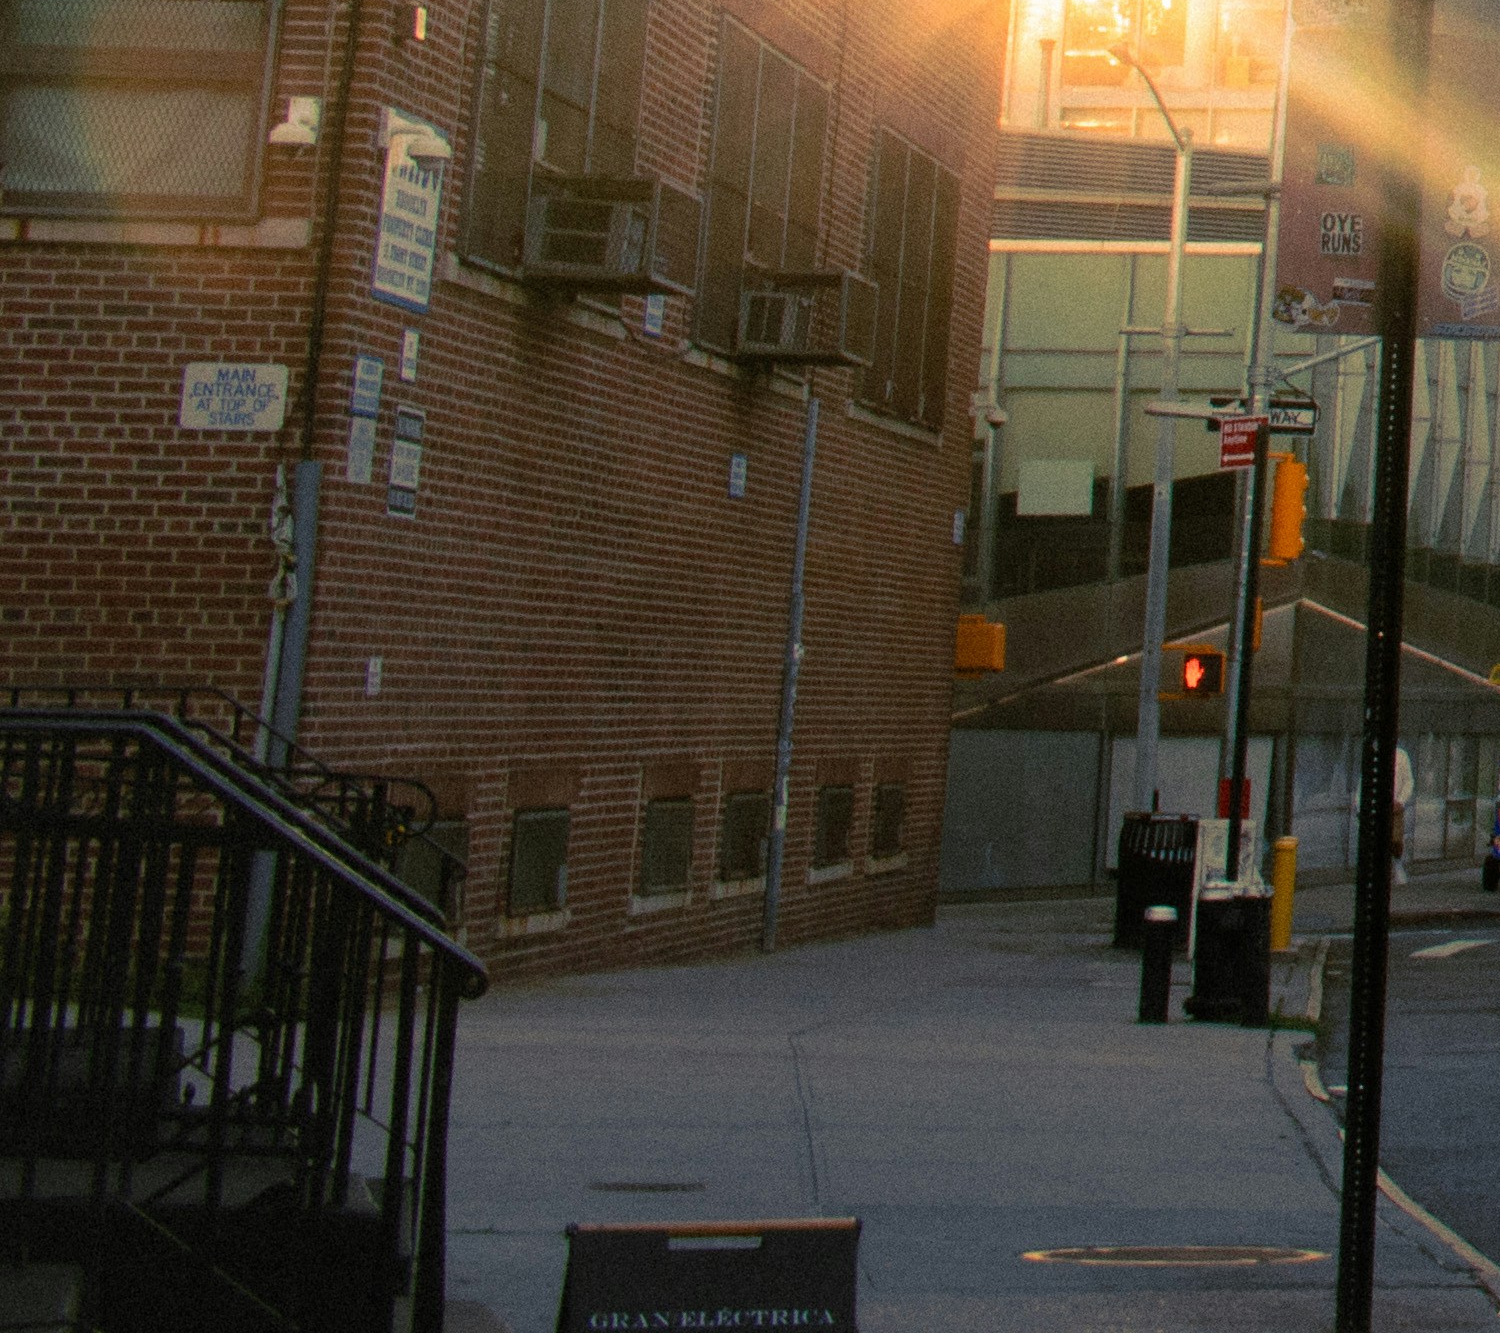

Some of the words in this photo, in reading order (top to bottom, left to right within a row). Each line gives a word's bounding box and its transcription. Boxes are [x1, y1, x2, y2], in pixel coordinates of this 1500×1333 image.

[1323, 214, 1361, 232] OYE
[1322, 235, 1361, 253] RUNS
[217, 369, 255, 381] MAIN
[193, 382, 274, 396] ENTRANCE
[196, 398, 212, 411] AT
[220, 399, 246, 411] TOP
[254, 399, 272, 412] OF
[208, 412, 255, 425] STAIRS
[1270, 411, 1300, 424] WAY
[589, 1312, 669, 1329] GRAN
[680, 1307, 835, 1329] ELÉCTRICA
